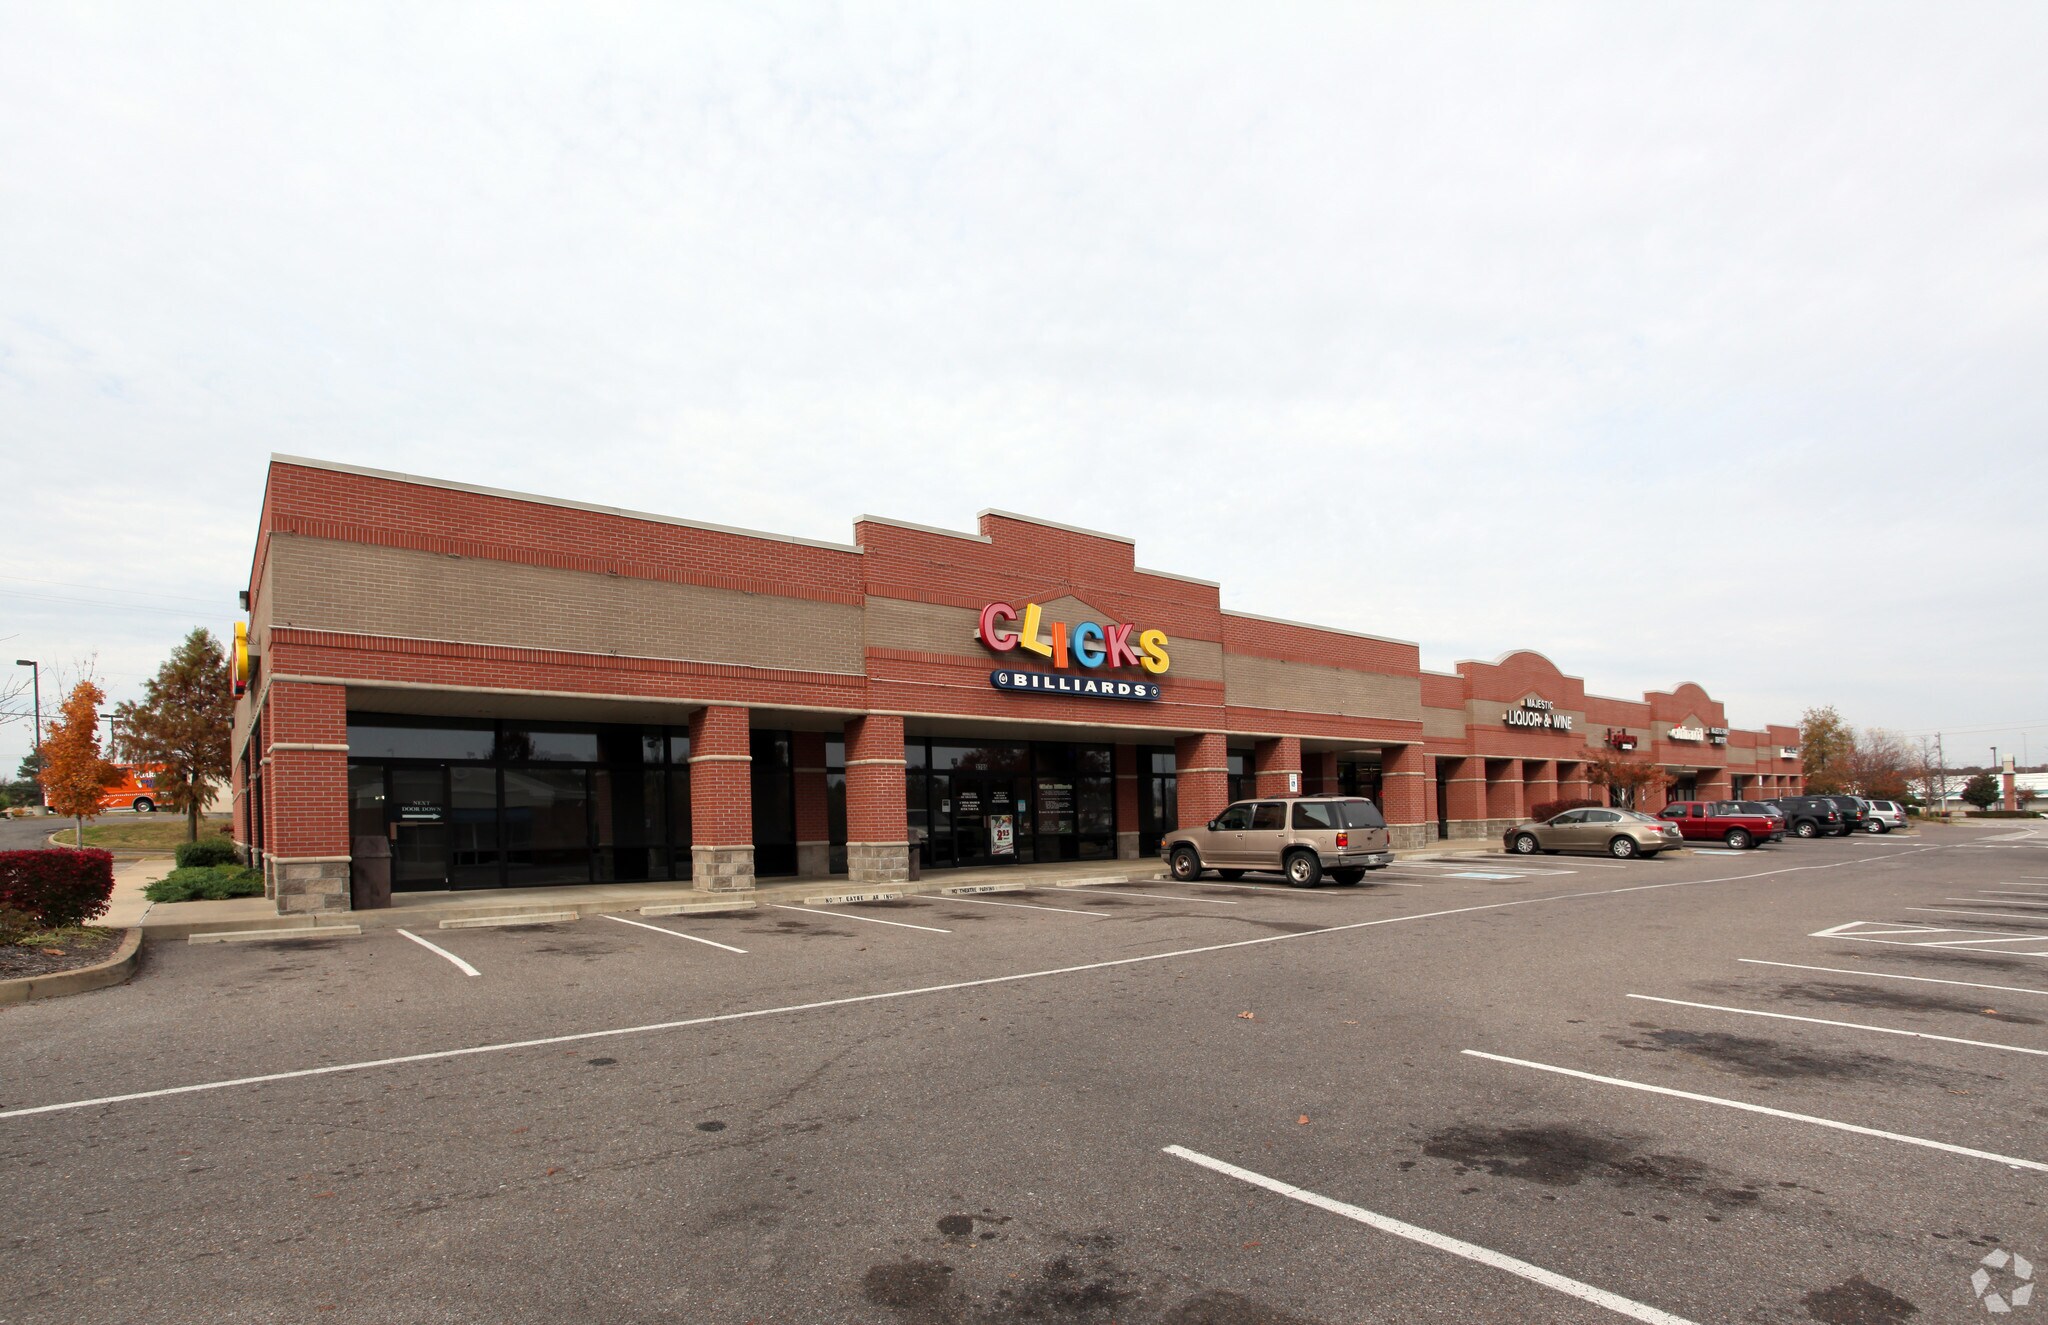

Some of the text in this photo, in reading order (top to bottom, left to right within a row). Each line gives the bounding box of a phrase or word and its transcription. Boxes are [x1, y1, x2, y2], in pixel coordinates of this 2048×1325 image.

[979, 601, 1170, 674] CLICKS
[1014, 673, 1147, 696] BILLIARDS
[1526, 698, 1554, 710] MAJESTIC
[1508, 709, 1572, 729] LIQUOR & WINE
